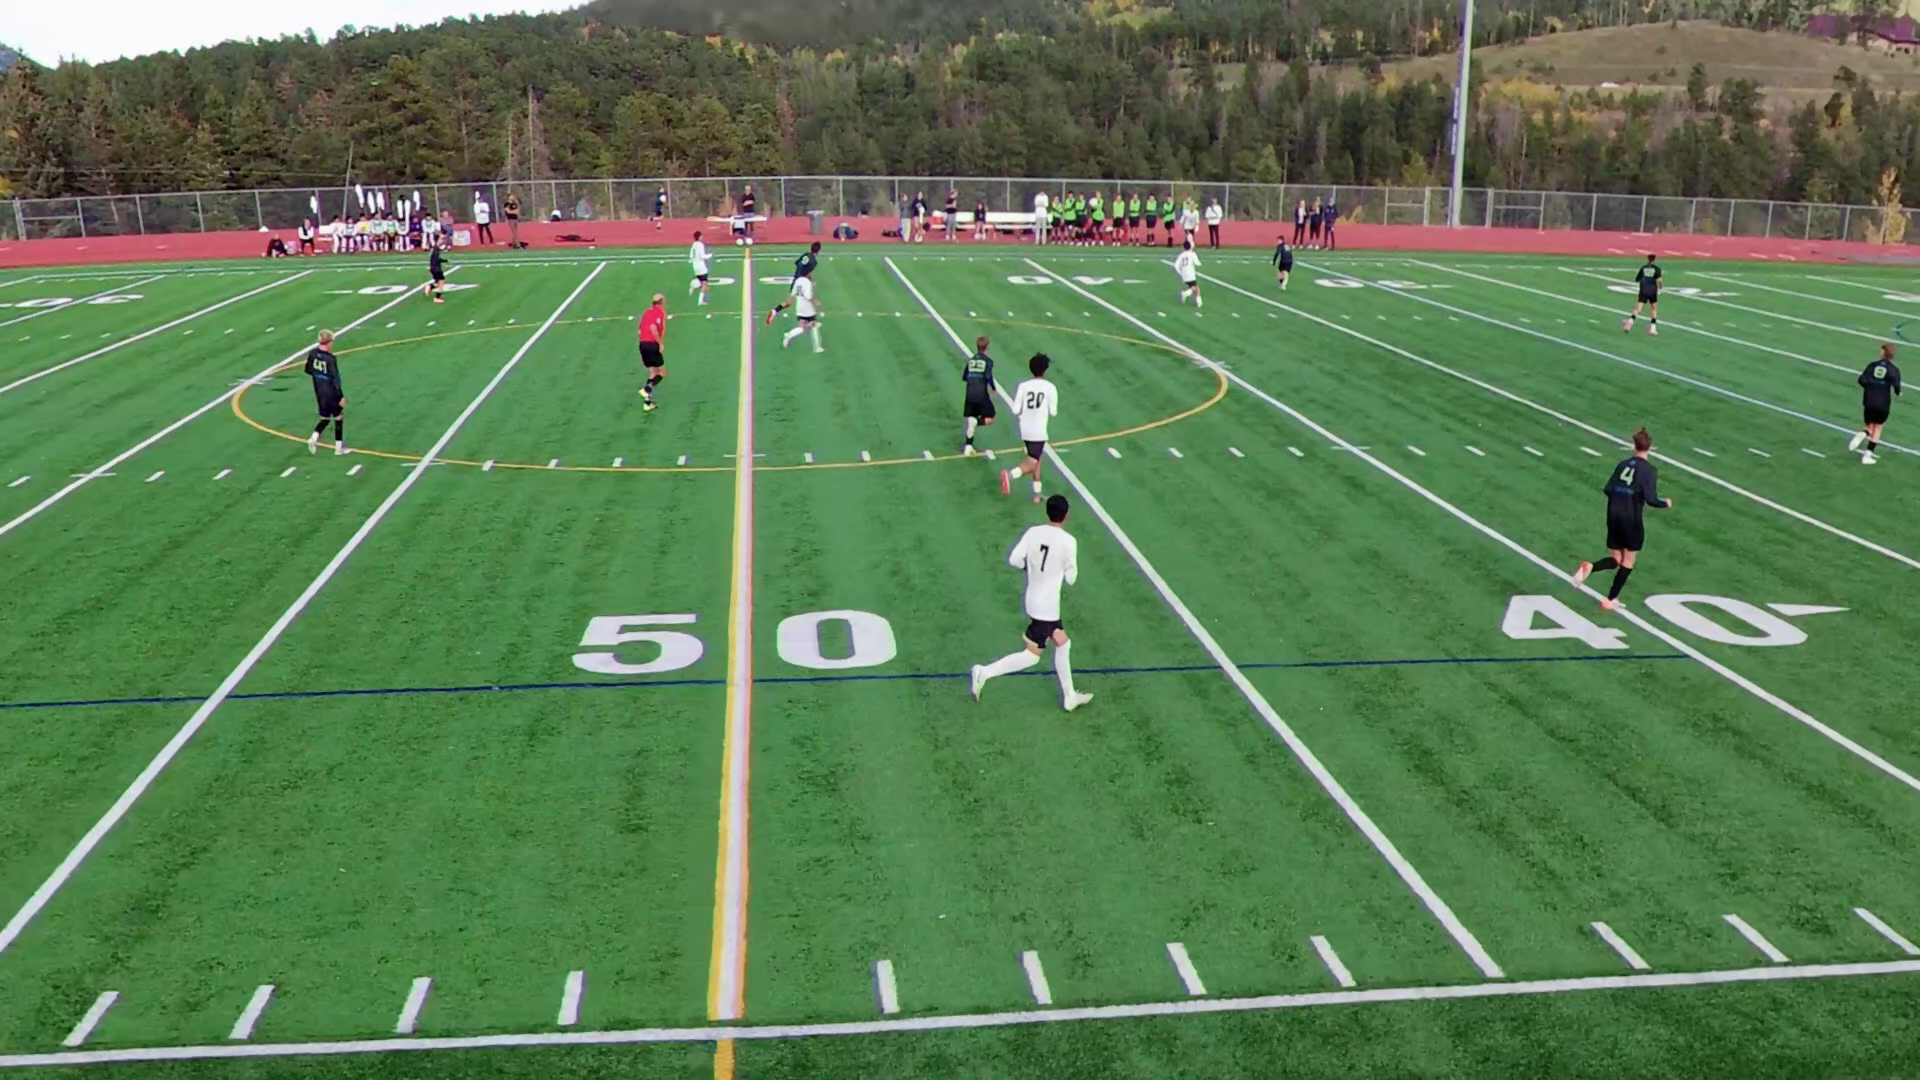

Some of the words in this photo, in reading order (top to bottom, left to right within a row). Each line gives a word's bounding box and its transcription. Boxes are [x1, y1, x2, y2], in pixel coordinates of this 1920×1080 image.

[1027, 391, 1045, 409] 20
[1619, 466, 1635, 486] 4
[1039, 543, 1050, 572] 7
